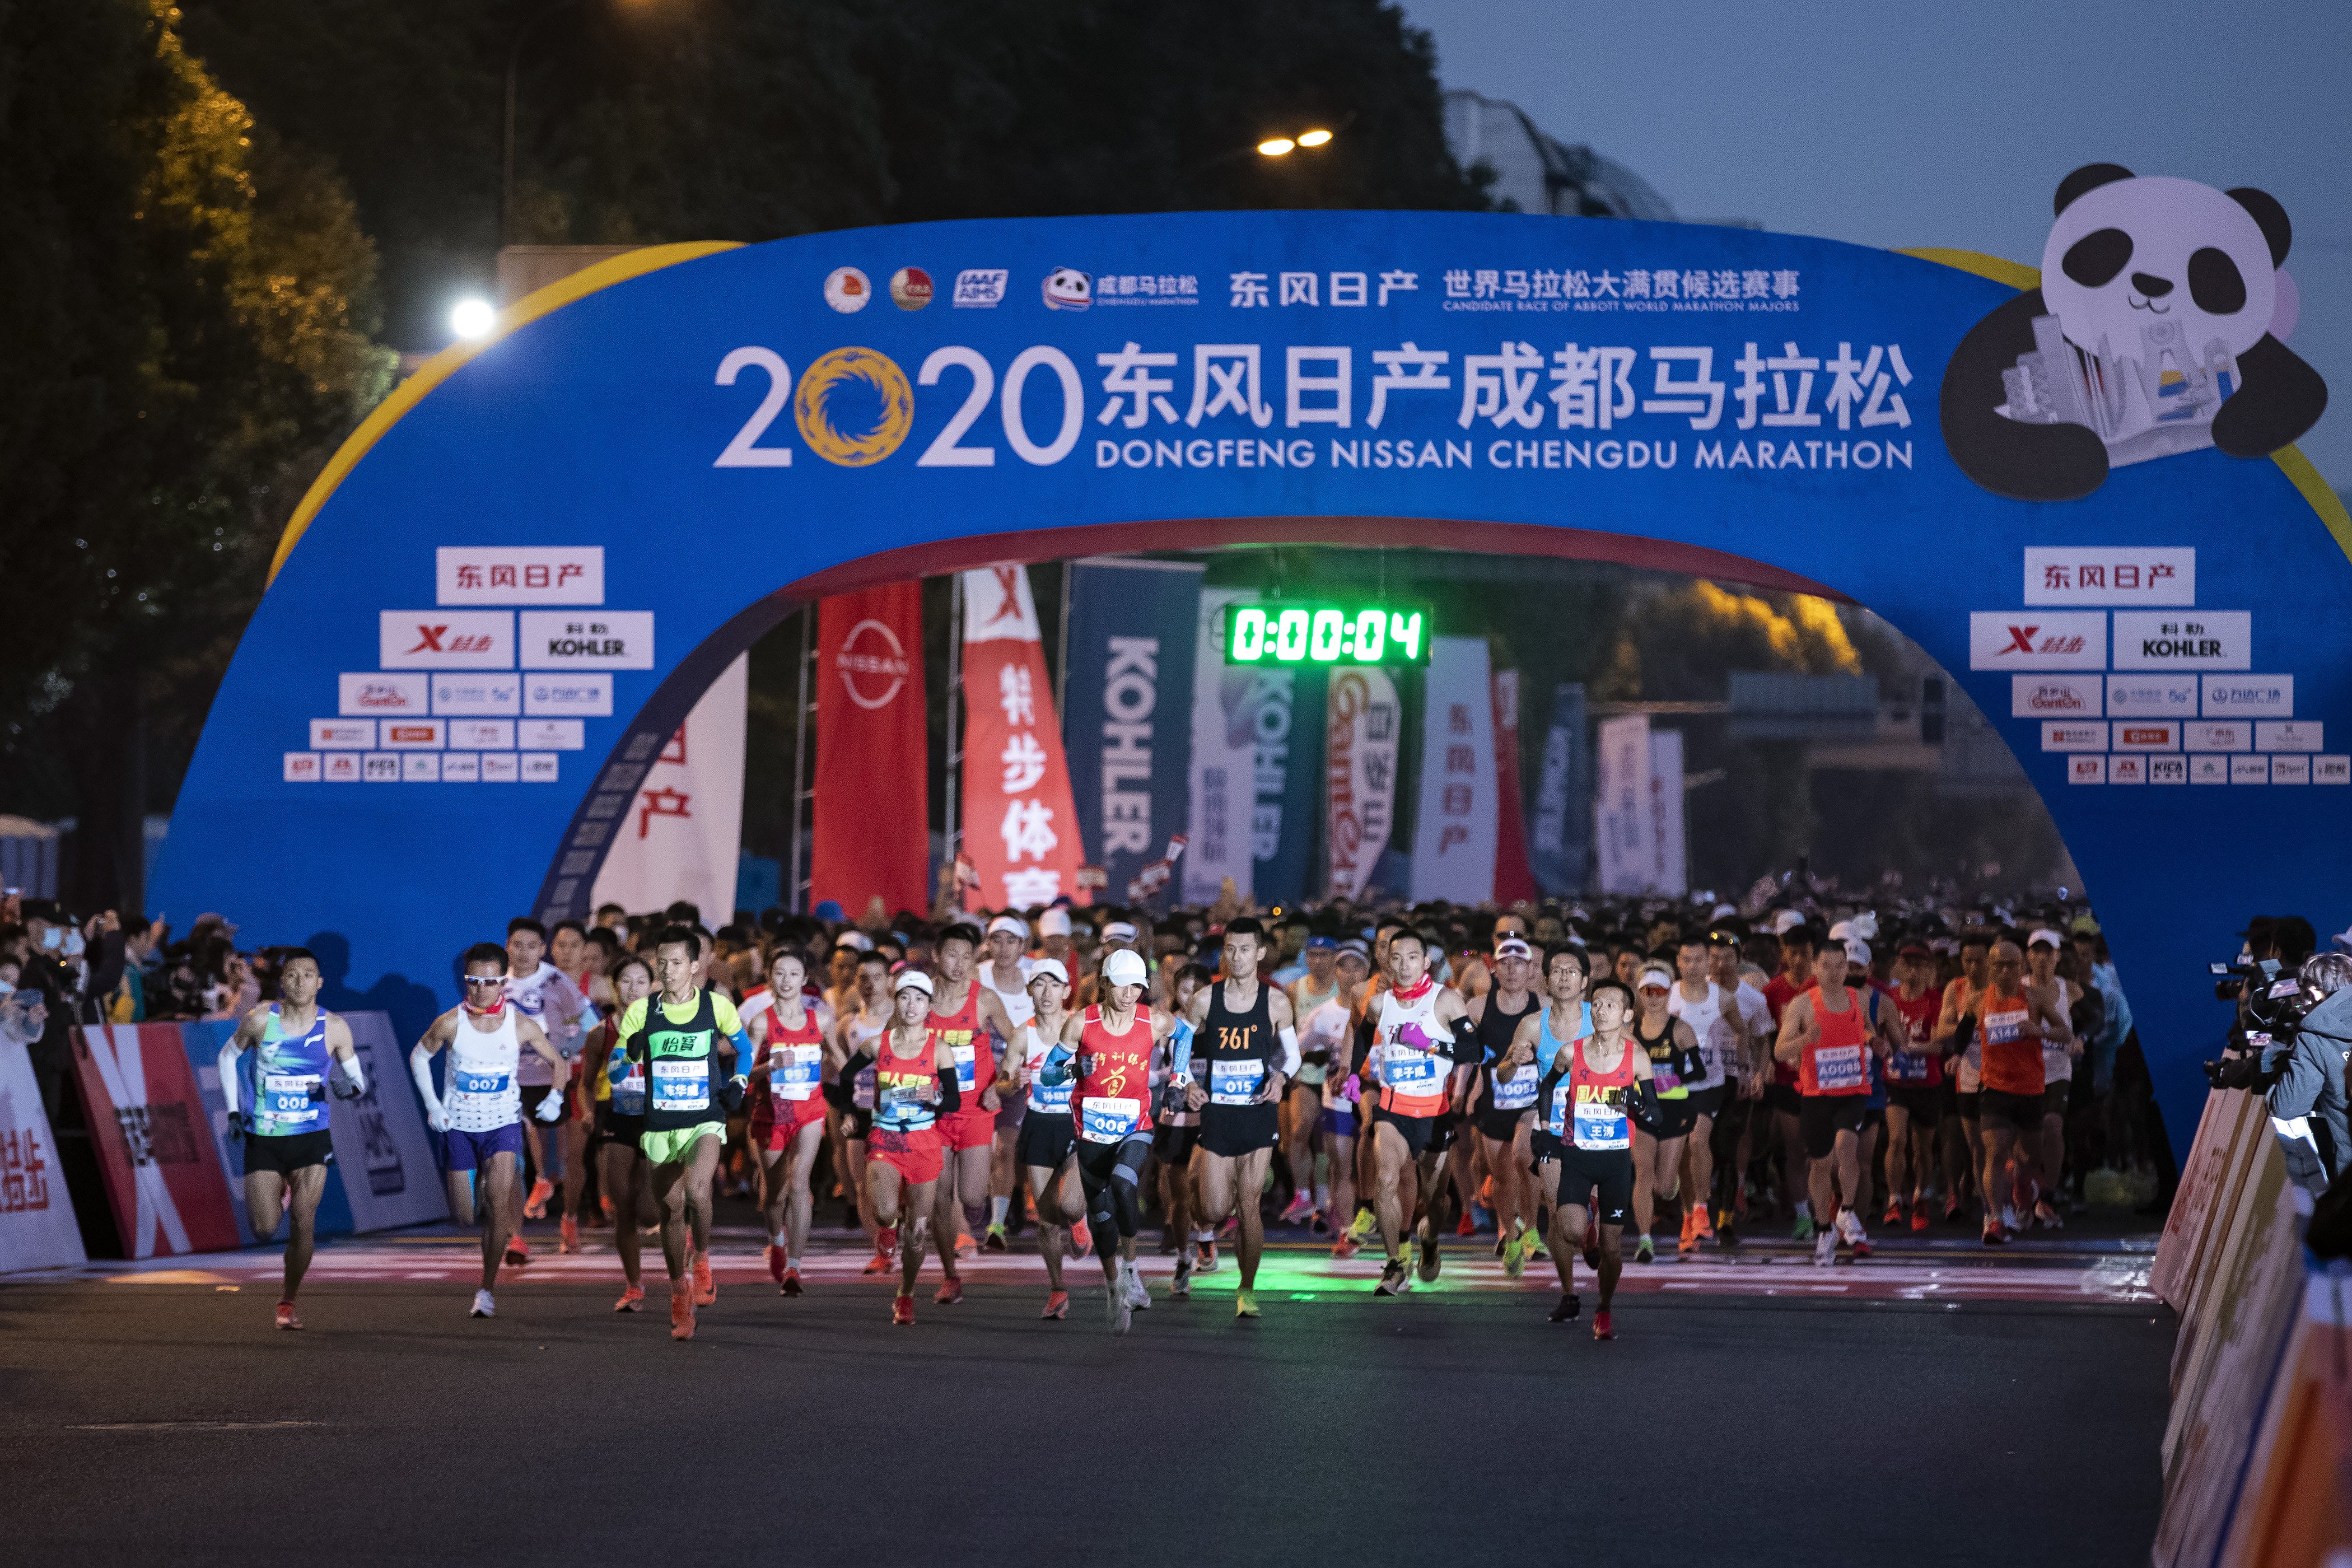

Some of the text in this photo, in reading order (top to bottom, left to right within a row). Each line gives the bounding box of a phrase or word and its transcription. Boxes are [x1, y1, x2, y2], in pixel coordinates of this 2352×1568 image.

[1230, 269, 1419, 308] 东风日产
[1443, 269, 1800, 299] 世界马拉松大满贯候选赛事
[1443, 301, 1514, 312] CANDIDATE
[1673, 301, 1745, 312] MARATHON
[1096, 340, 1914, 431] 东风日产成都马拉松
[713, 346, 1085, 468] 2020
[1096, 439, 1913, 469] DONGFENG NISSAN CHENGDU MARATHON
[457, 563, 584, 590] 东风日产
[2045, 563, 2176, 590] 东风日产
[1232, 609, 1422, 661] 0:00:04
[2160, 622, 2205, 636] 科勒
[549, 639, 624, 657] KOHLER
[2142, 640, 2222, 658] KOHLER
[837, 653, 909, 674] NISSAN
[1103, 636, 1160, 854] KOHLER
[662, 1035, 698, 1052] 怡寶
[1218, 1024, 1258, 1049] 361°
[469, 1079, 499, 1091] 007
[1225, 1080, 1254, 1093] 015
[1095, 1118, 1127, 1133] 006
